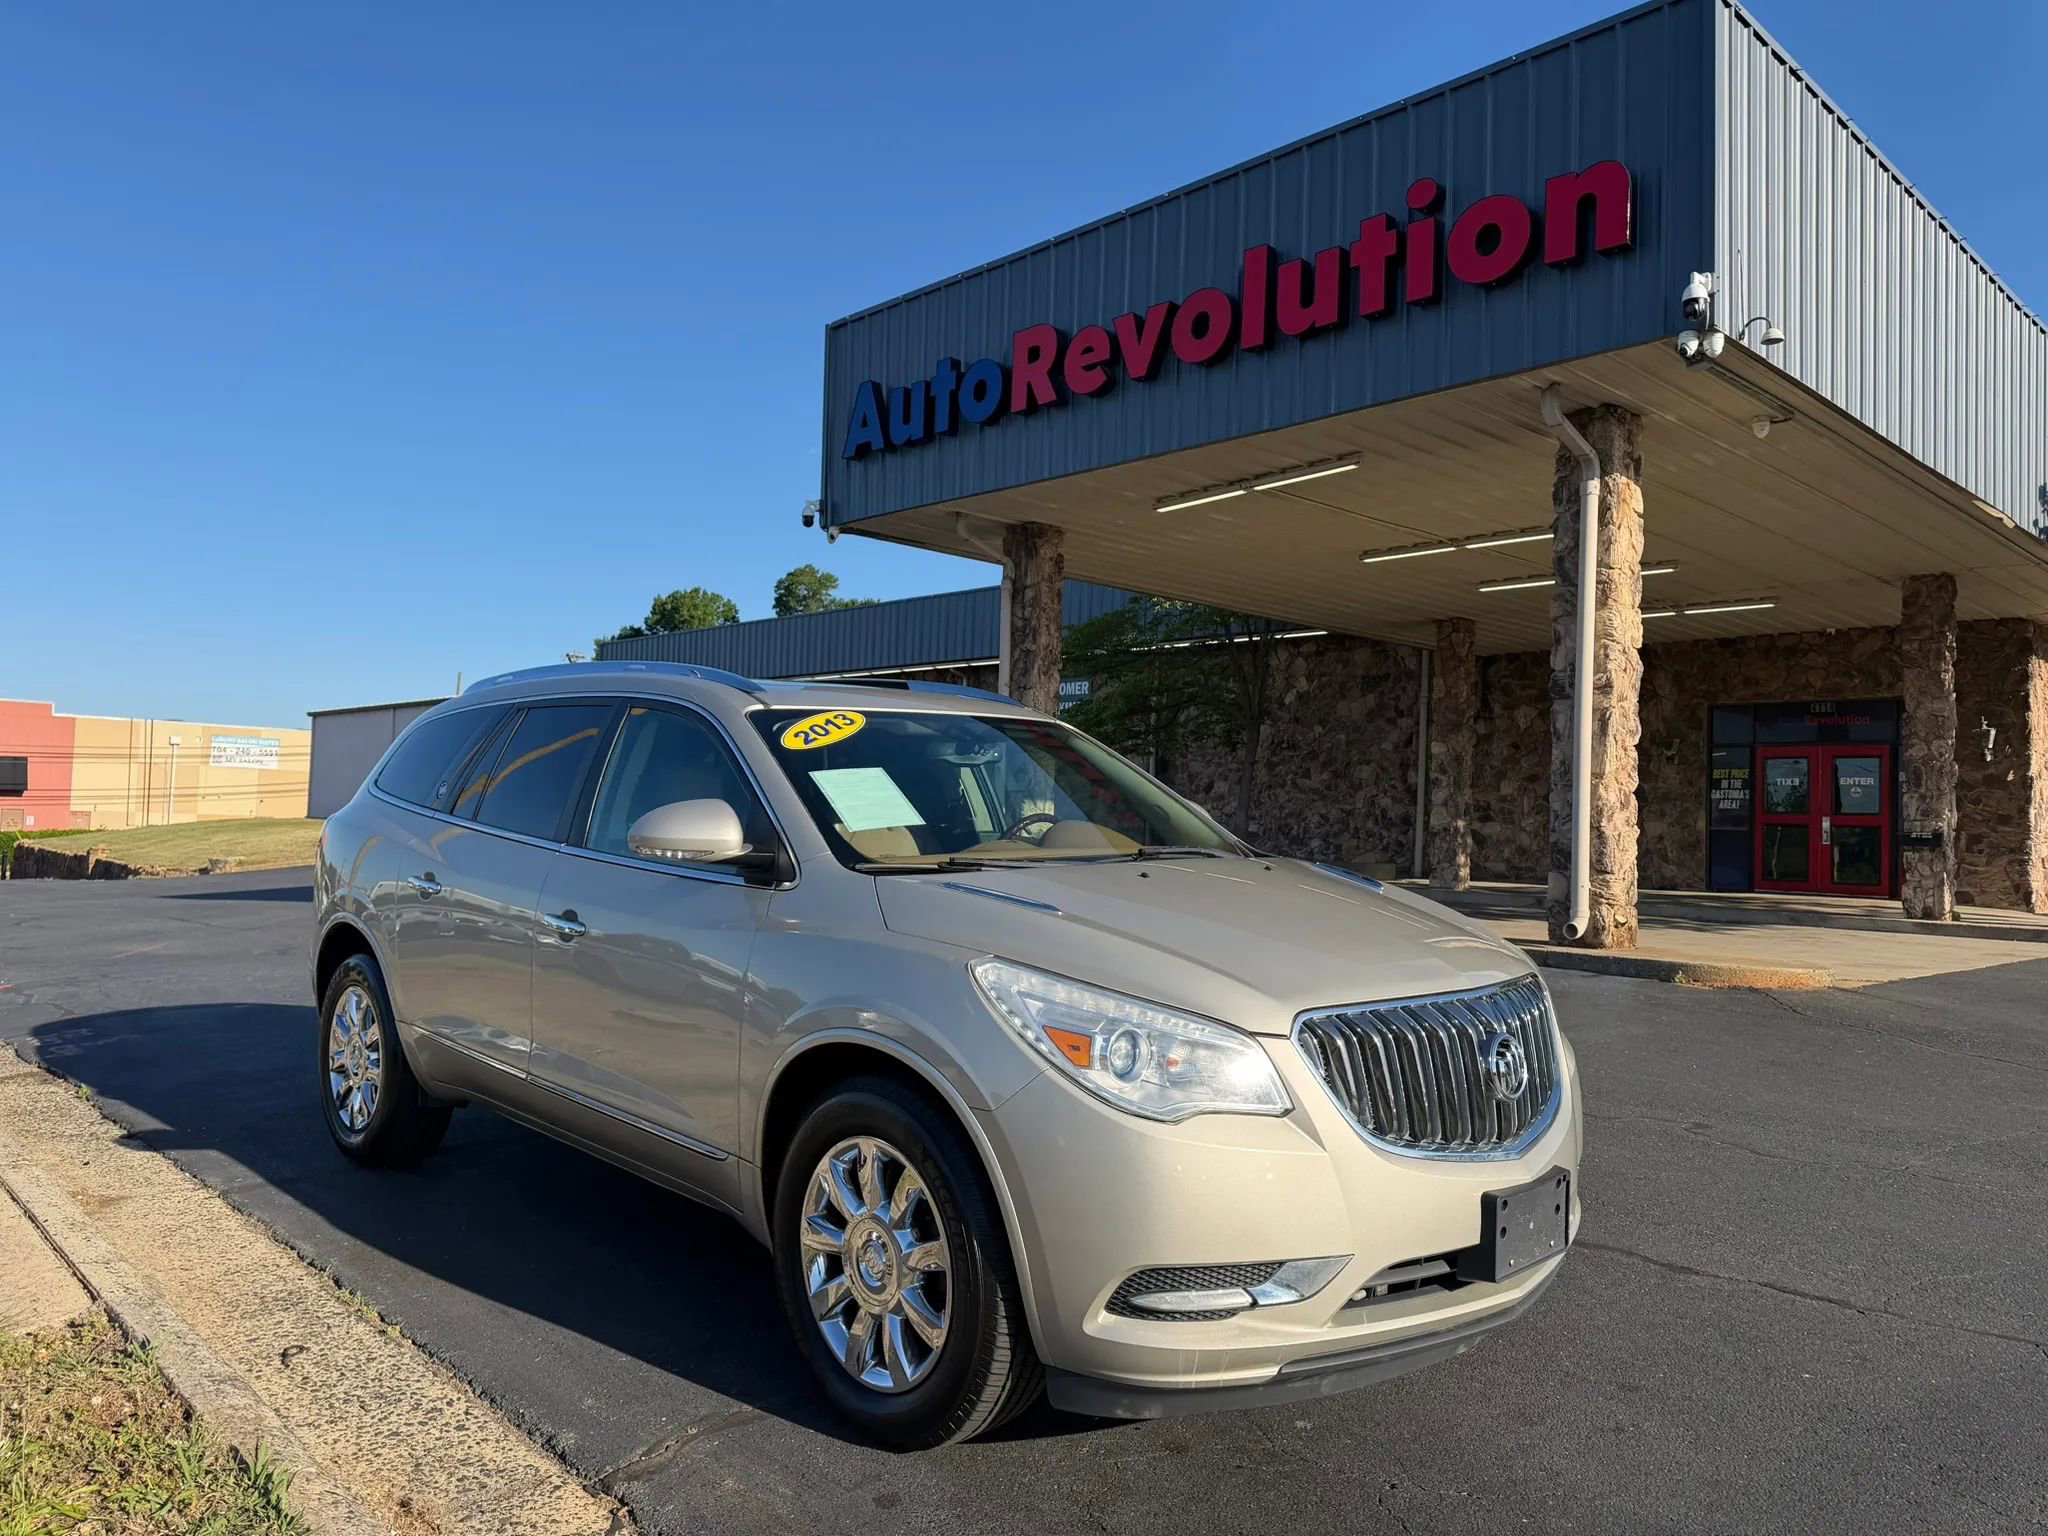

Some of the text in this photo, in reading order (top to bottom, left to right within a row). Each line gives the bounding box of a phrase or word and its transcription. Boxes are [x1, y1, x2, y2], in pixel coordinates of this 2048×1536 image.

[1059, 681, 1089, 695] OMER
[794, 713, 857, 746] 2013
[1712, 769, 1729, 779] BEST
[1730, 779, 1743, 789] THE
[1840, 777, 1874, 785] ENTER
